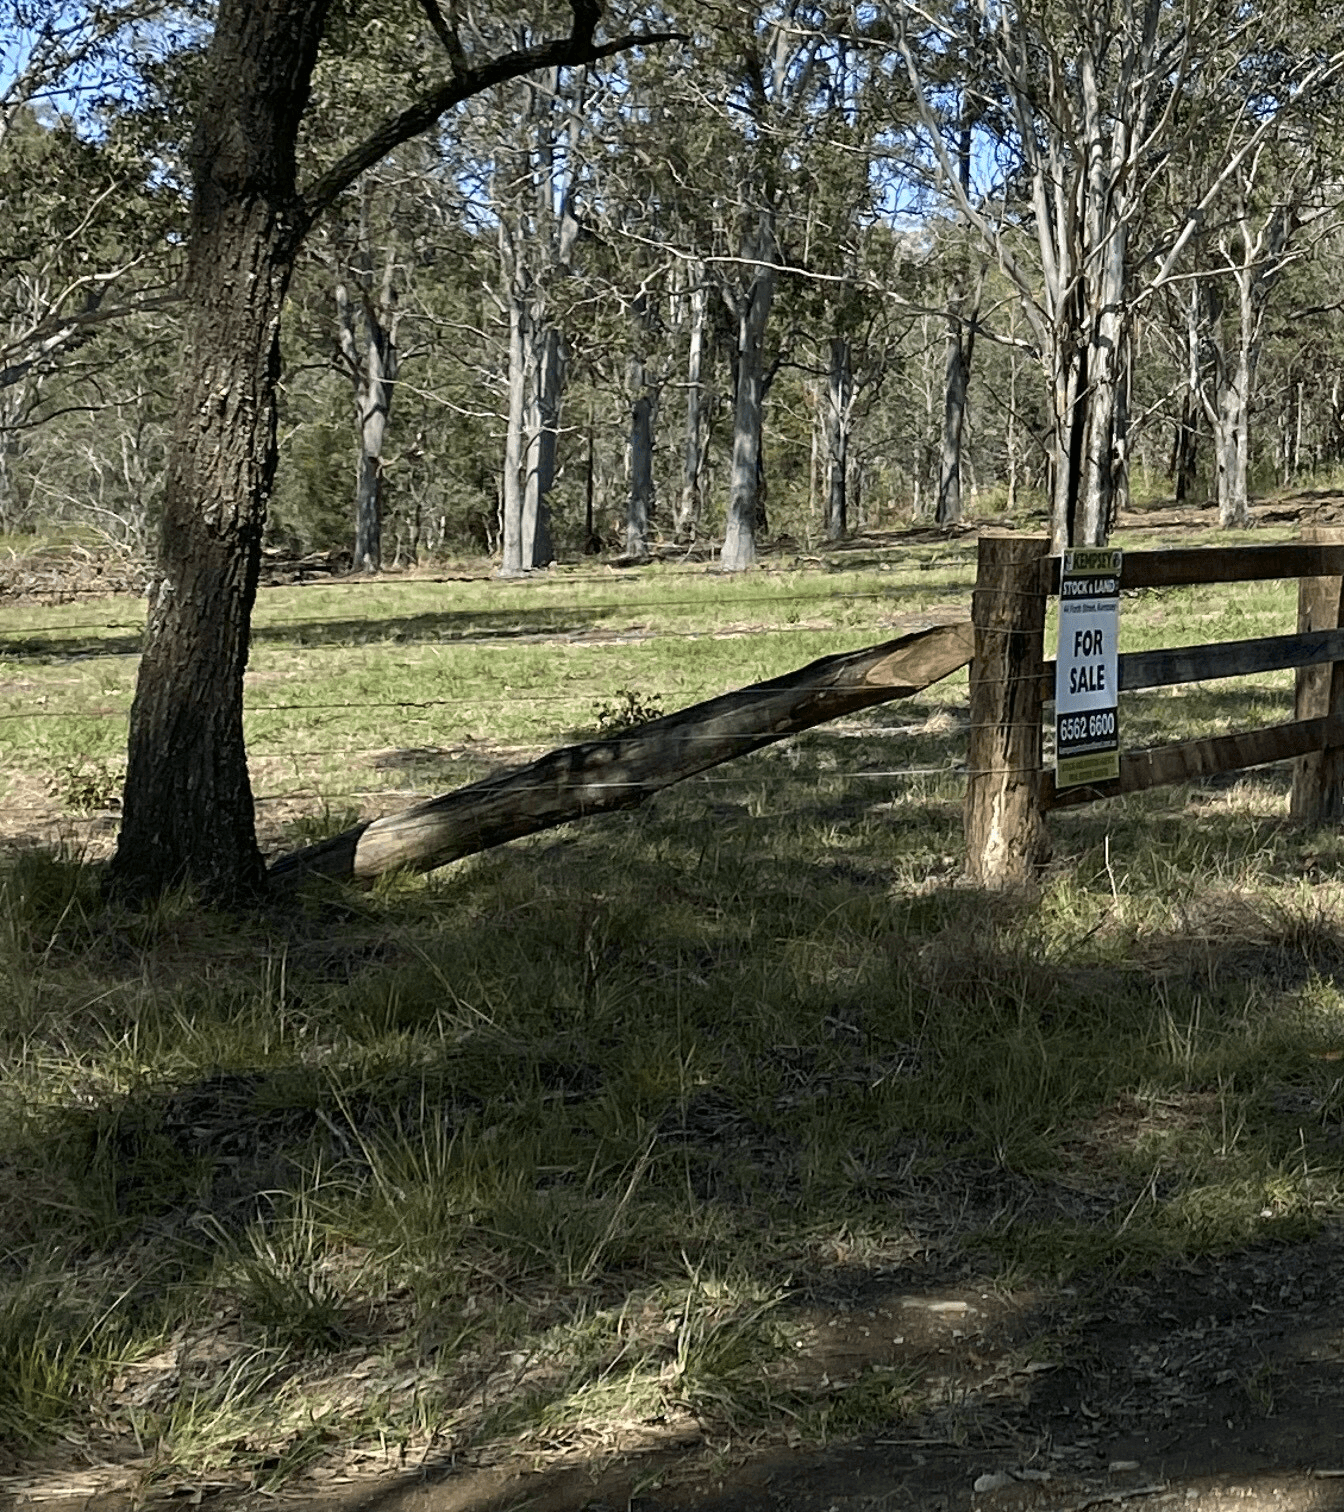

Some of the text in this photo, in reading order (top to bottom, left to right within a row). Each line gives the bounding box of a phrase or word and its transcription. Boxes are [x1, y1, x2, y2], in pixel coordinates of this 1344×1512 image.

[1074, 552, 1111, 570] KEMPSEY
[1063, 580, 1089, 596] STOCK
[1094, 579, 1115, 594] LAND
[1074, 629, 1103, 657] FOR
[1070, 664, 1105, 694] SALE
[1061, 712, 1115, 741] 6562 6600
